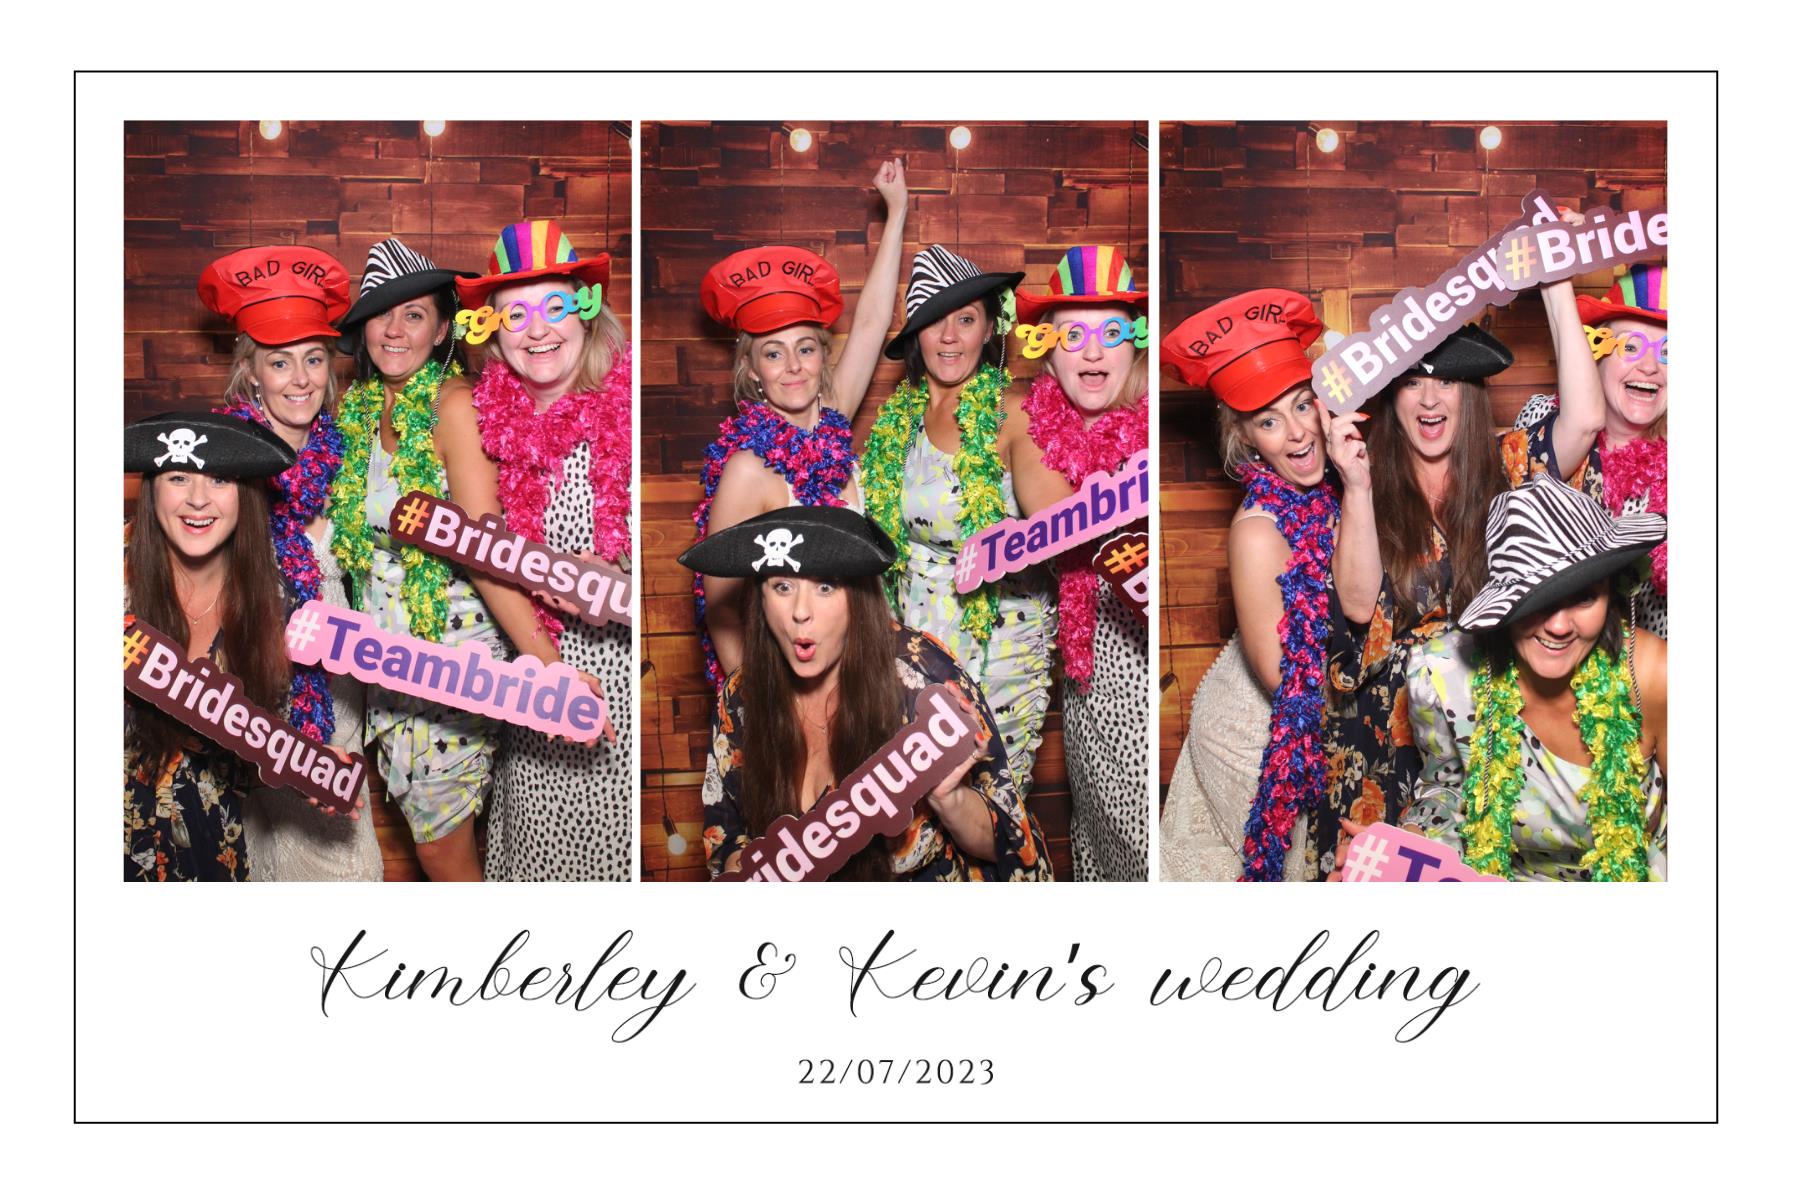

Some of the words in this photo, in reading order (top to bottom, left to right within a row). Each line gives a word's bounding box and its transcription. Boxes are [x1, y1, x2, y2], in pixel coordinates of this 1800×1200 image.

[234, 260, 280, 287] BAD
[729, 261, 771, 287] BAD
[1188, 316, 1233, 356] BAD
[287, 608, 600, 732] #Teambride
[123, 629, 364, 803] #Bridesquad
